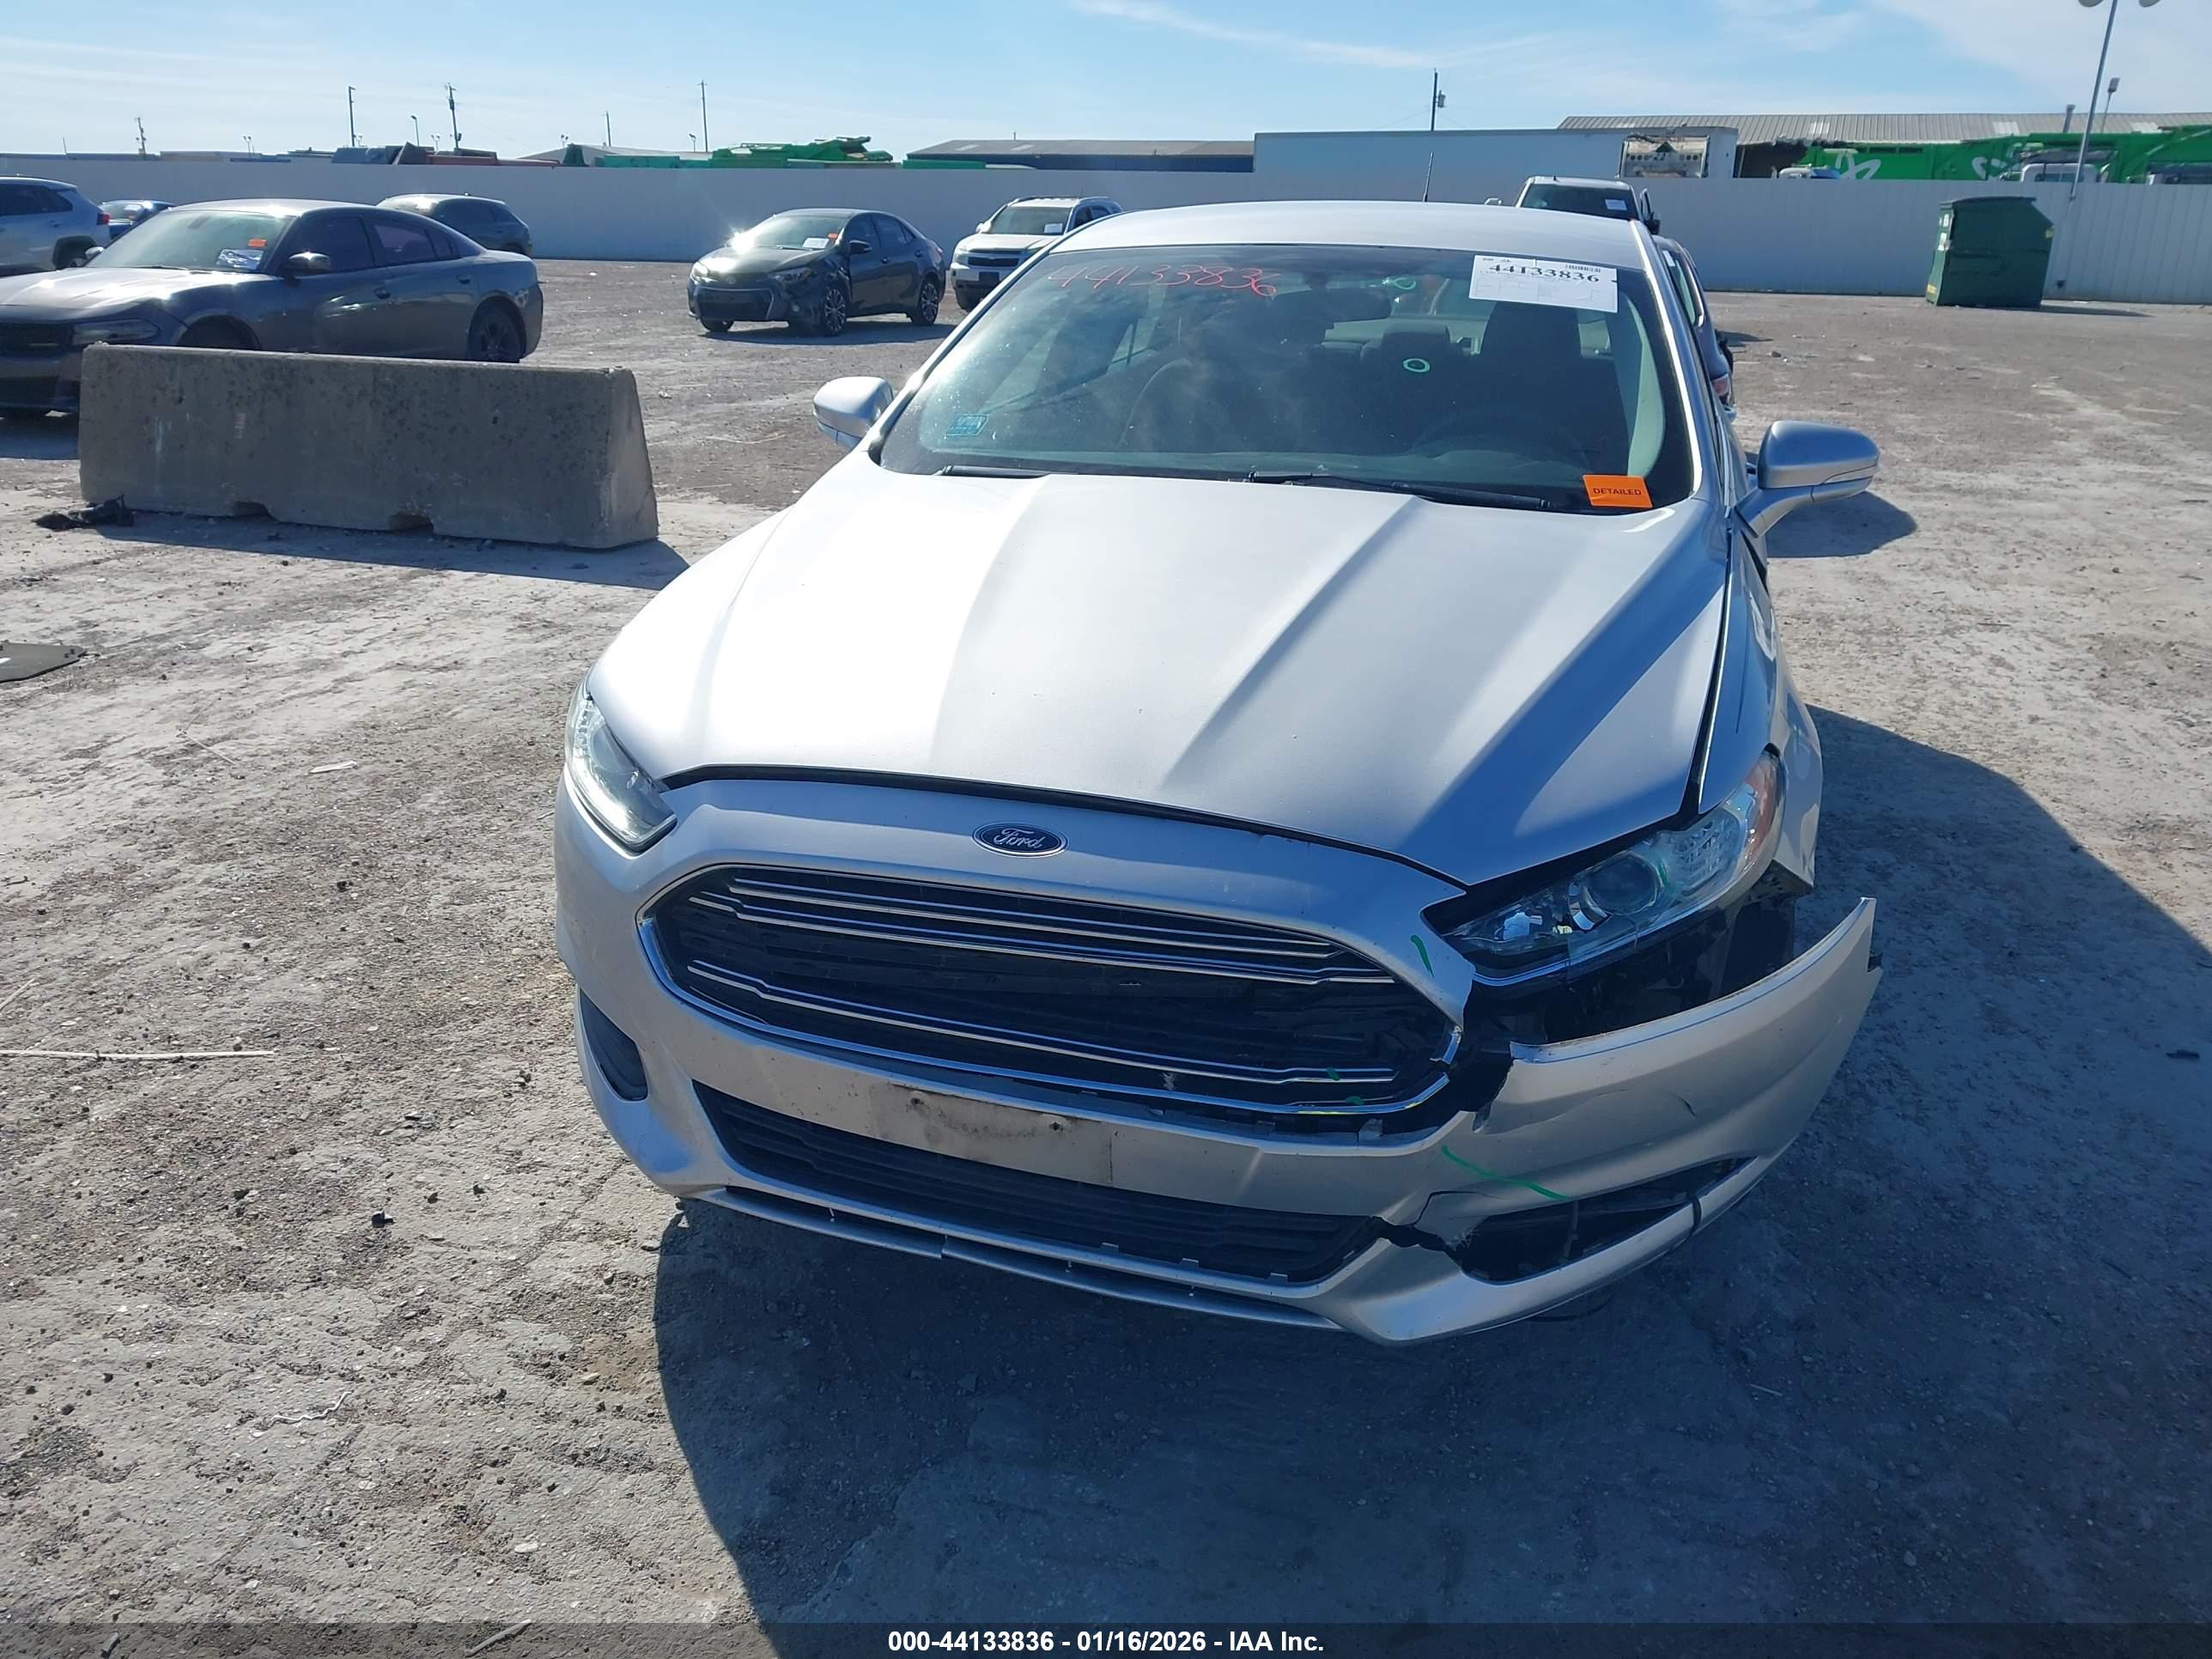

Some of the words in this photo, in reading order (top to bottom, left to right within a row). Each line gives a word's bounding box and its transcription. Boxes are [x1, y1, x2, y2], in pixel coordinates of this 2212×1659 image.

[1047, 264, 1282, 297] 44133836
[1488, 264, 1600, 283] 44133836
[1593, 487, 1642, 495] DETAILED
[993, 828, 1046, 848] Ford
